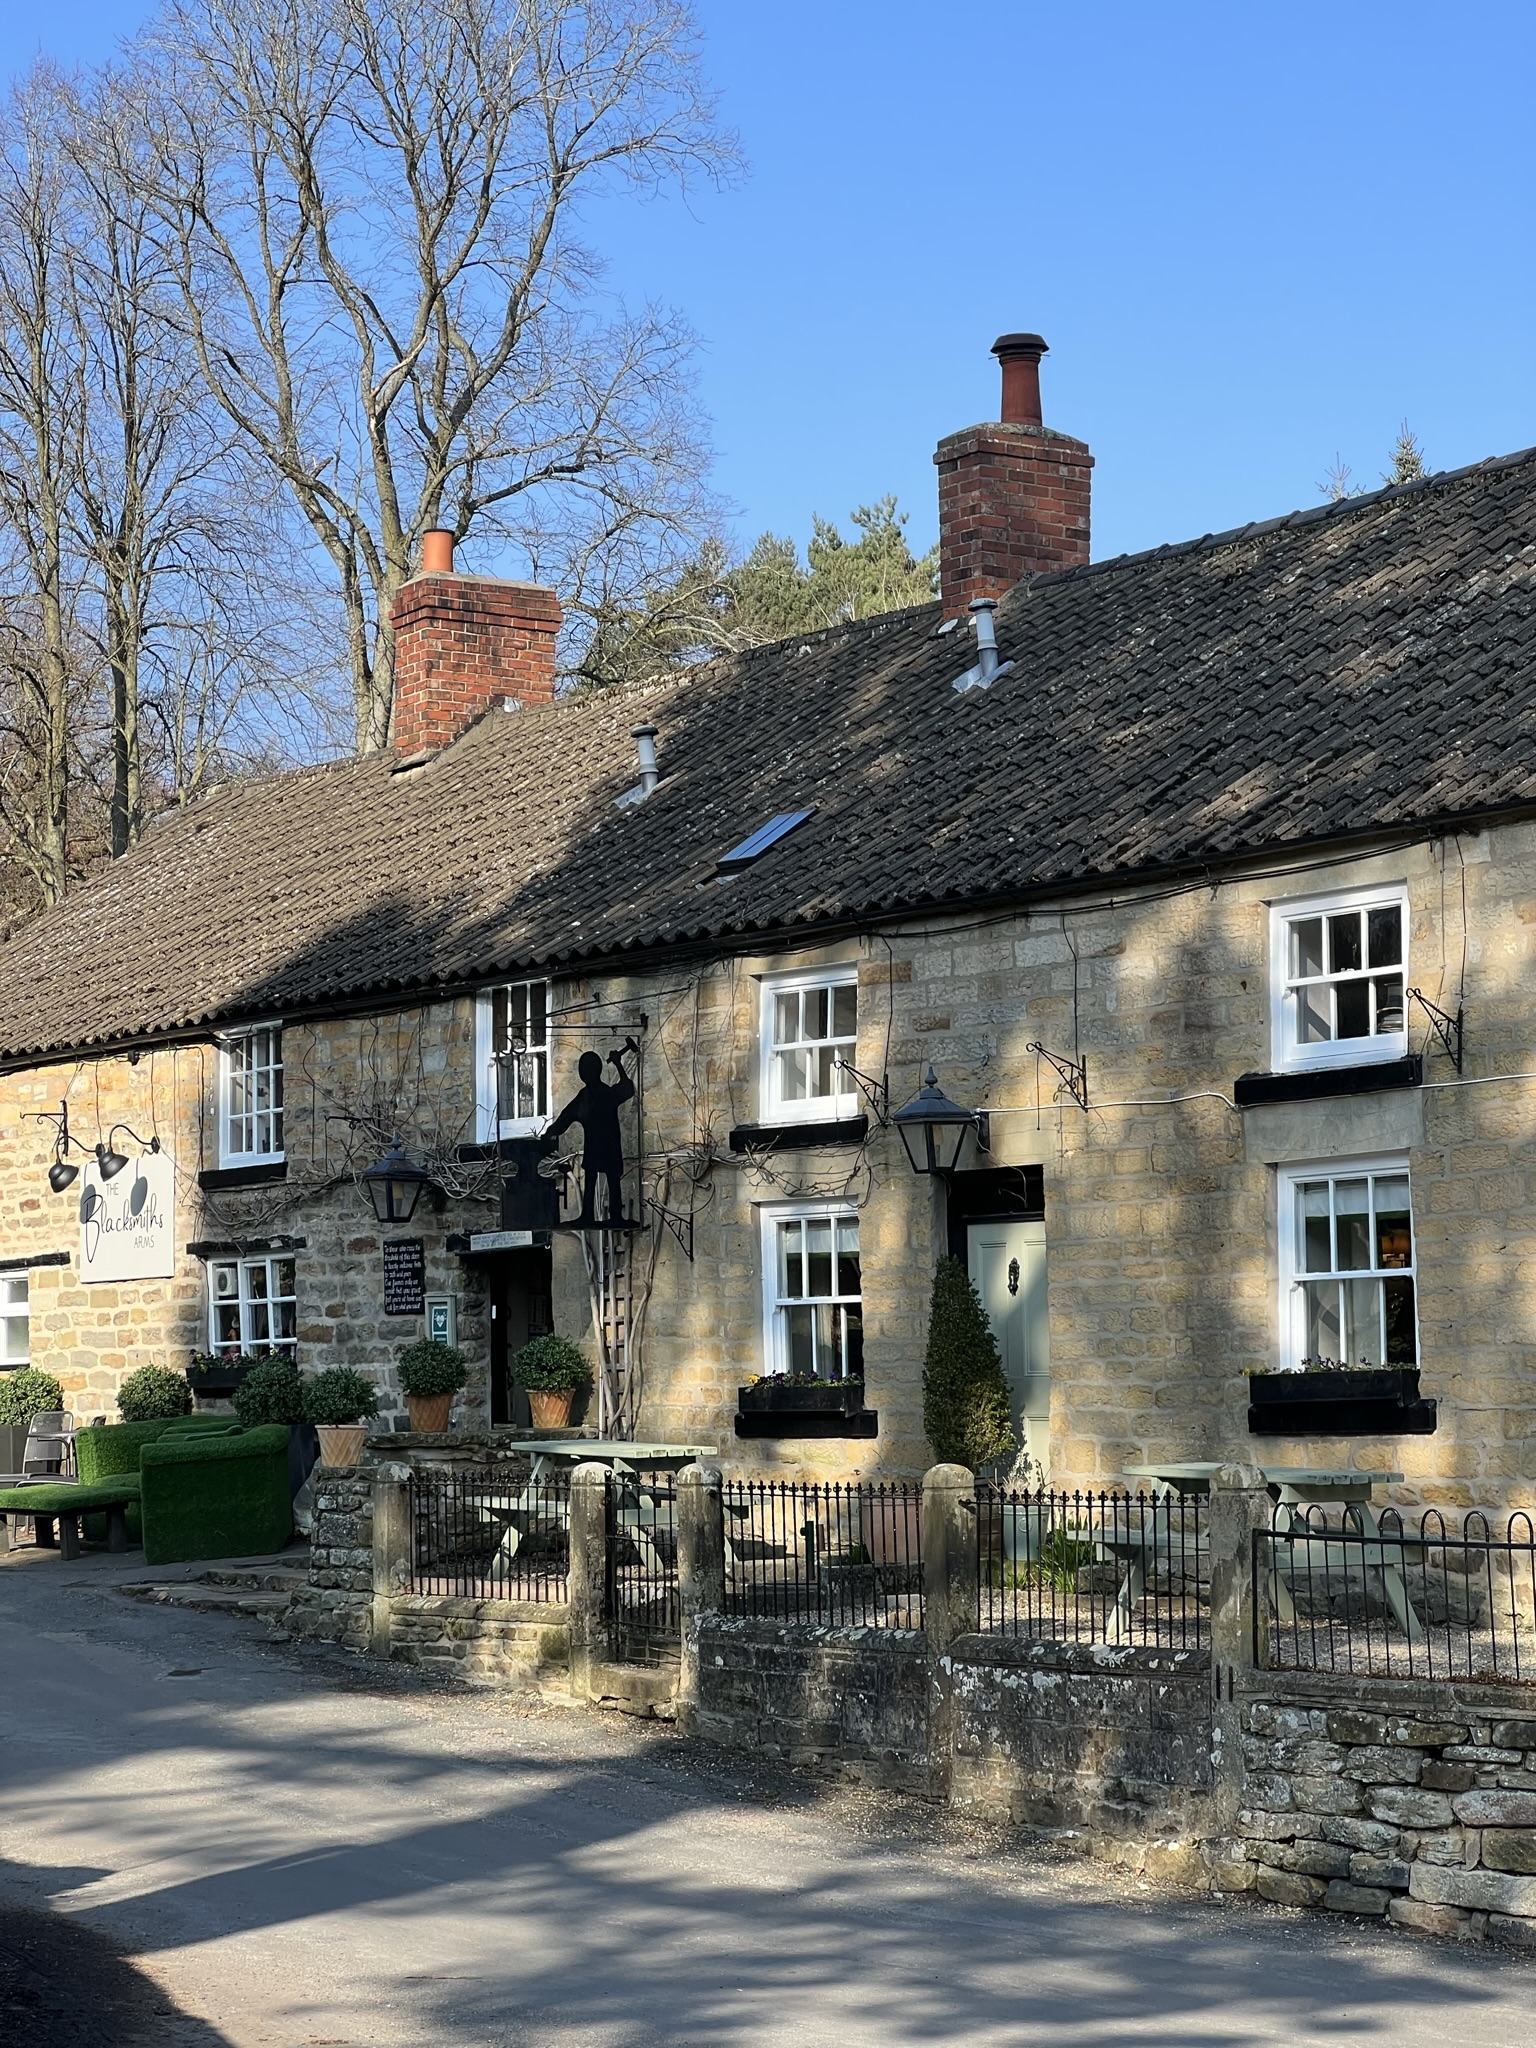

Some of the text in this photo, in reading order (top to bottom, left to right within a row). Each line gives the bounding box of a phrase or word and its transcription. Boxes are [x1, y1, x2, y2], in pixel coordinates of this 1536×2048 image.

[106, 1182, 119, 1196] THE
[83, 1192, 163, 1263] Blacksmiths
[134, 1236, 154, 1248] ARMS
